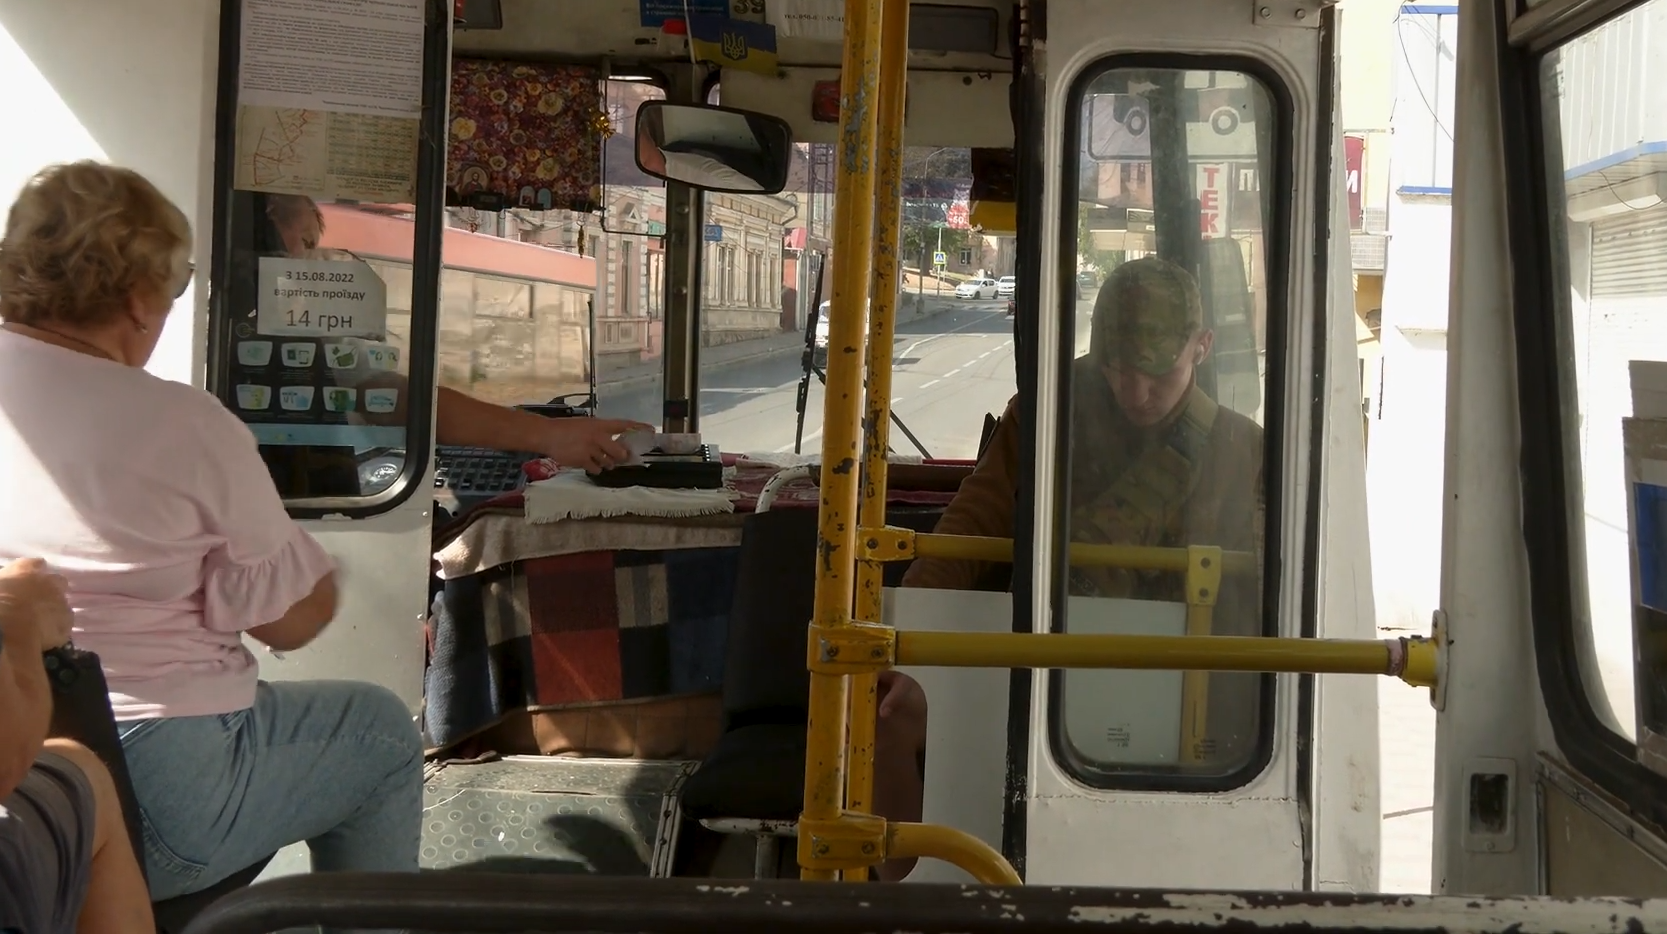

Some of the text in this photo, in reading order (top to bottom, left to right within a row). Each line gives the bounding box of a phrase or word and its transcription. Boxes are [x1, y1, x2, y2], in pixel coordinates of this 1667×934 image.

[295, 271, 354, 283] 15.08.2022
[274, 288, 366, 301] вартість проїзду
[286, 310, 352, 331] 14 грн
